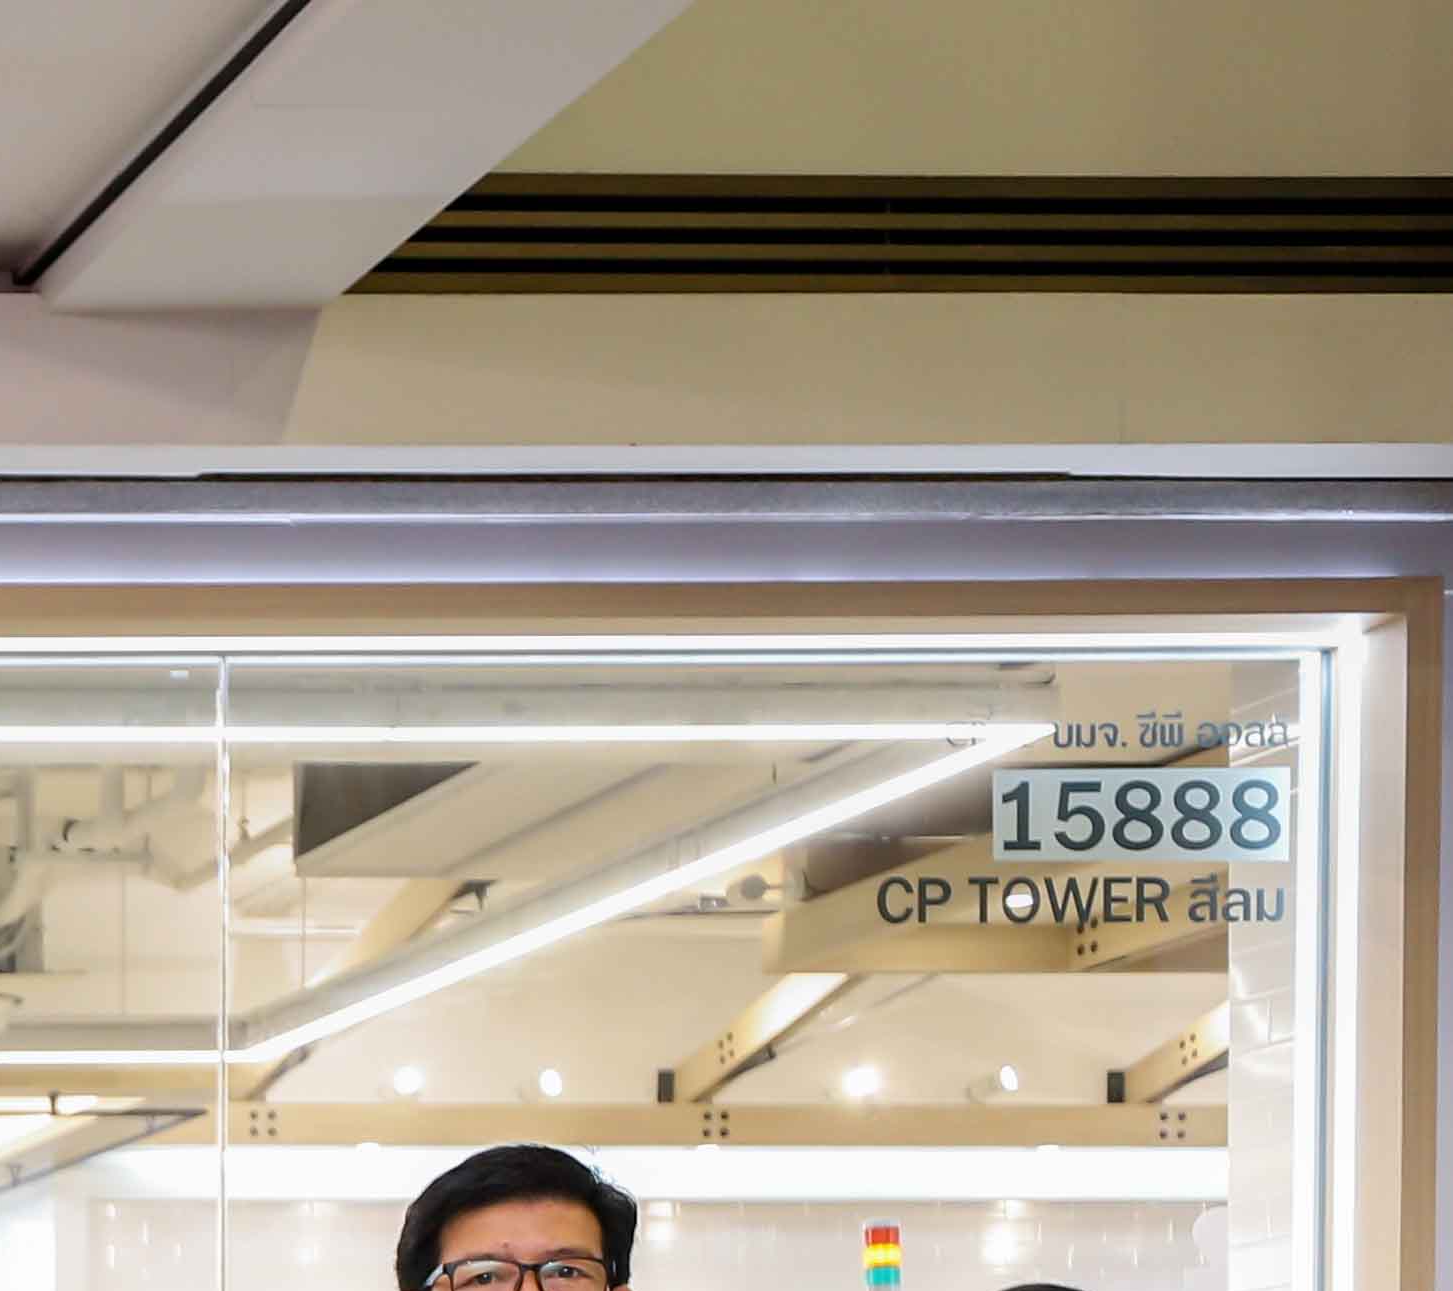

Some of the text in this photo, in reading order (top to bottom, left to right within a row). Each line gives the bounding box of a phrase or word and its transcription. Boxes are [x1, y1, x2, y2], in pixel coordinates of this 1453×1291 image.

[1000, 779, 1282, 852] 15888
[876, 872, 1285, 926] CP TOWER สีลม
